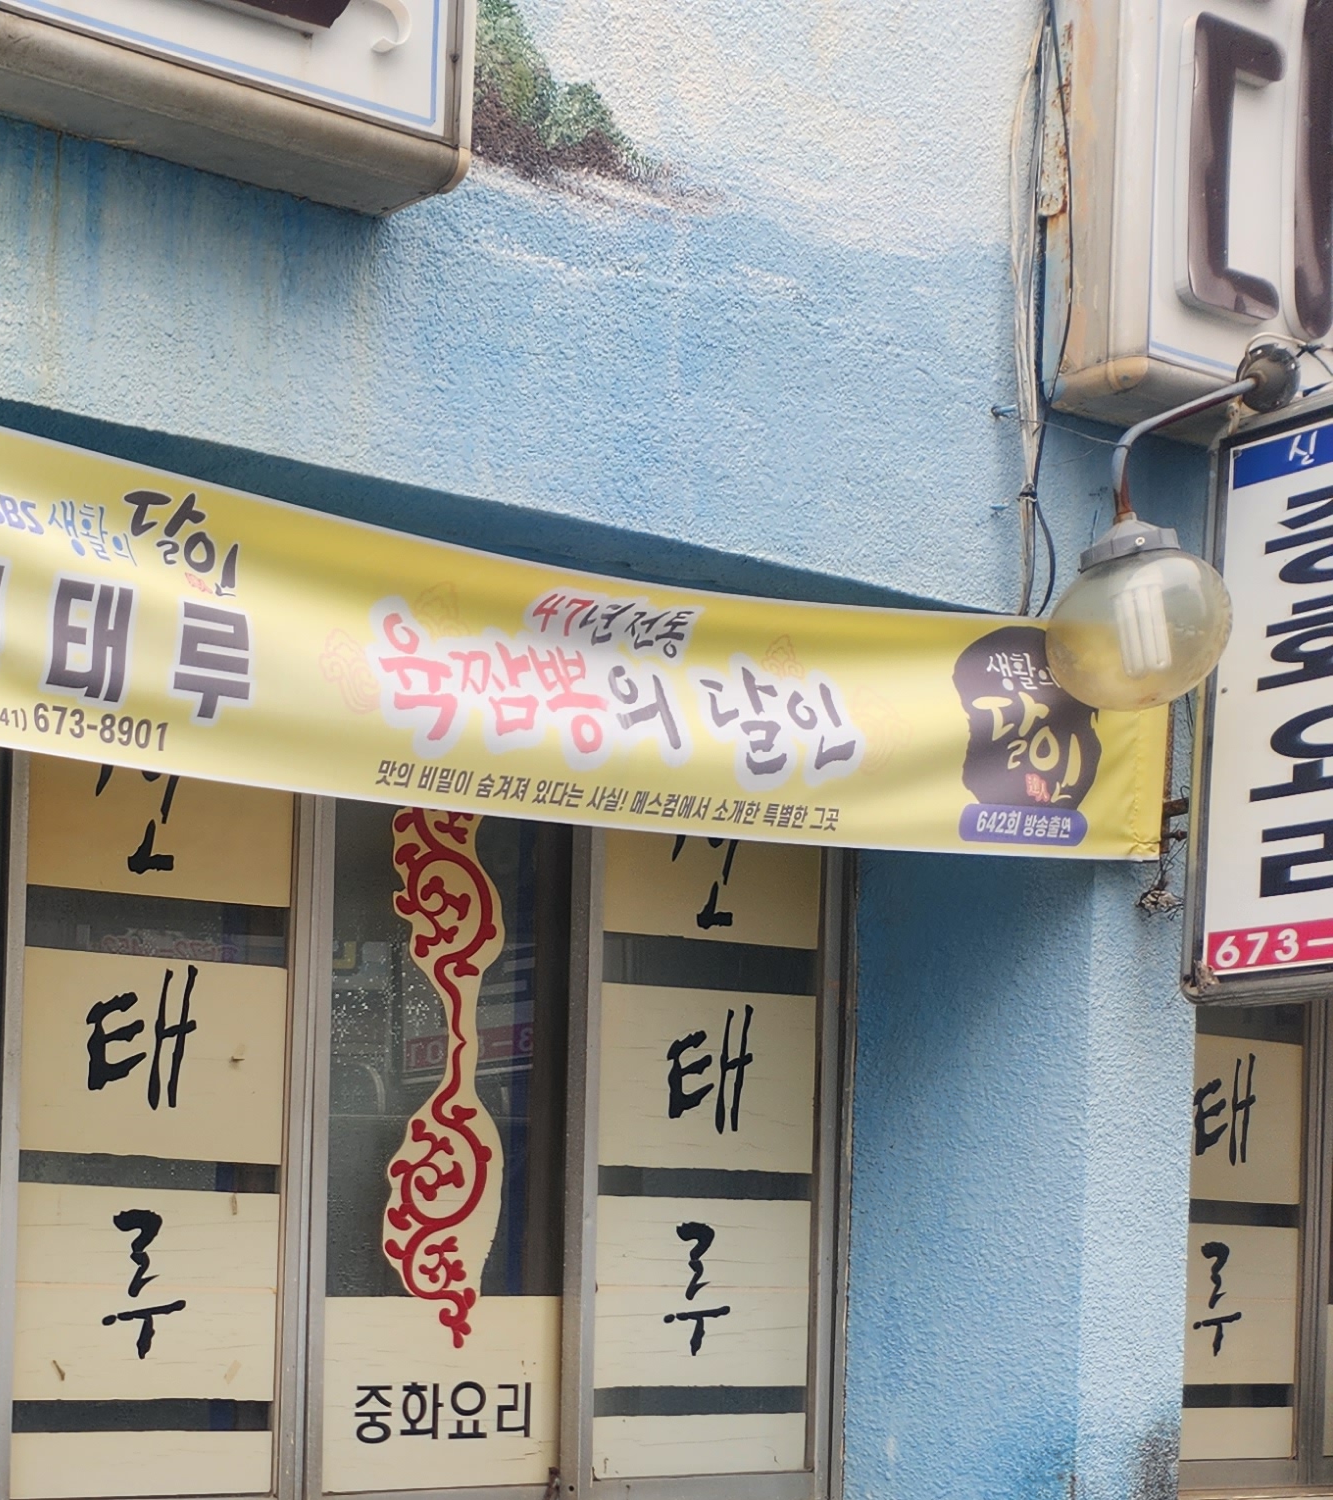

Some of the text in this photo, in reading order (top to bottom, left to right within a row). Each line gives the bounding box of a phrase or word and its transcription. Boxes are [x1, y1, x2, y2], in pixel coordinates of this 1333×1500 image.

[48, 500, 137, 566] 생활의
[123, 490, 238, 597] 달인
[33, 702, 169, 752] 673-8901
[699, 667, 858, 776] 달인
[971, 691, 1083, 803] 달인
[375, 760, 840, 832] 맛의 비밀이 숨겨져 있다는 사실! 메스컴에서 소개한 특별한 그곳
[976, 810, 1071, 839] 642회 방송출연
[354, 1380, 533, 1445] 중화요리
